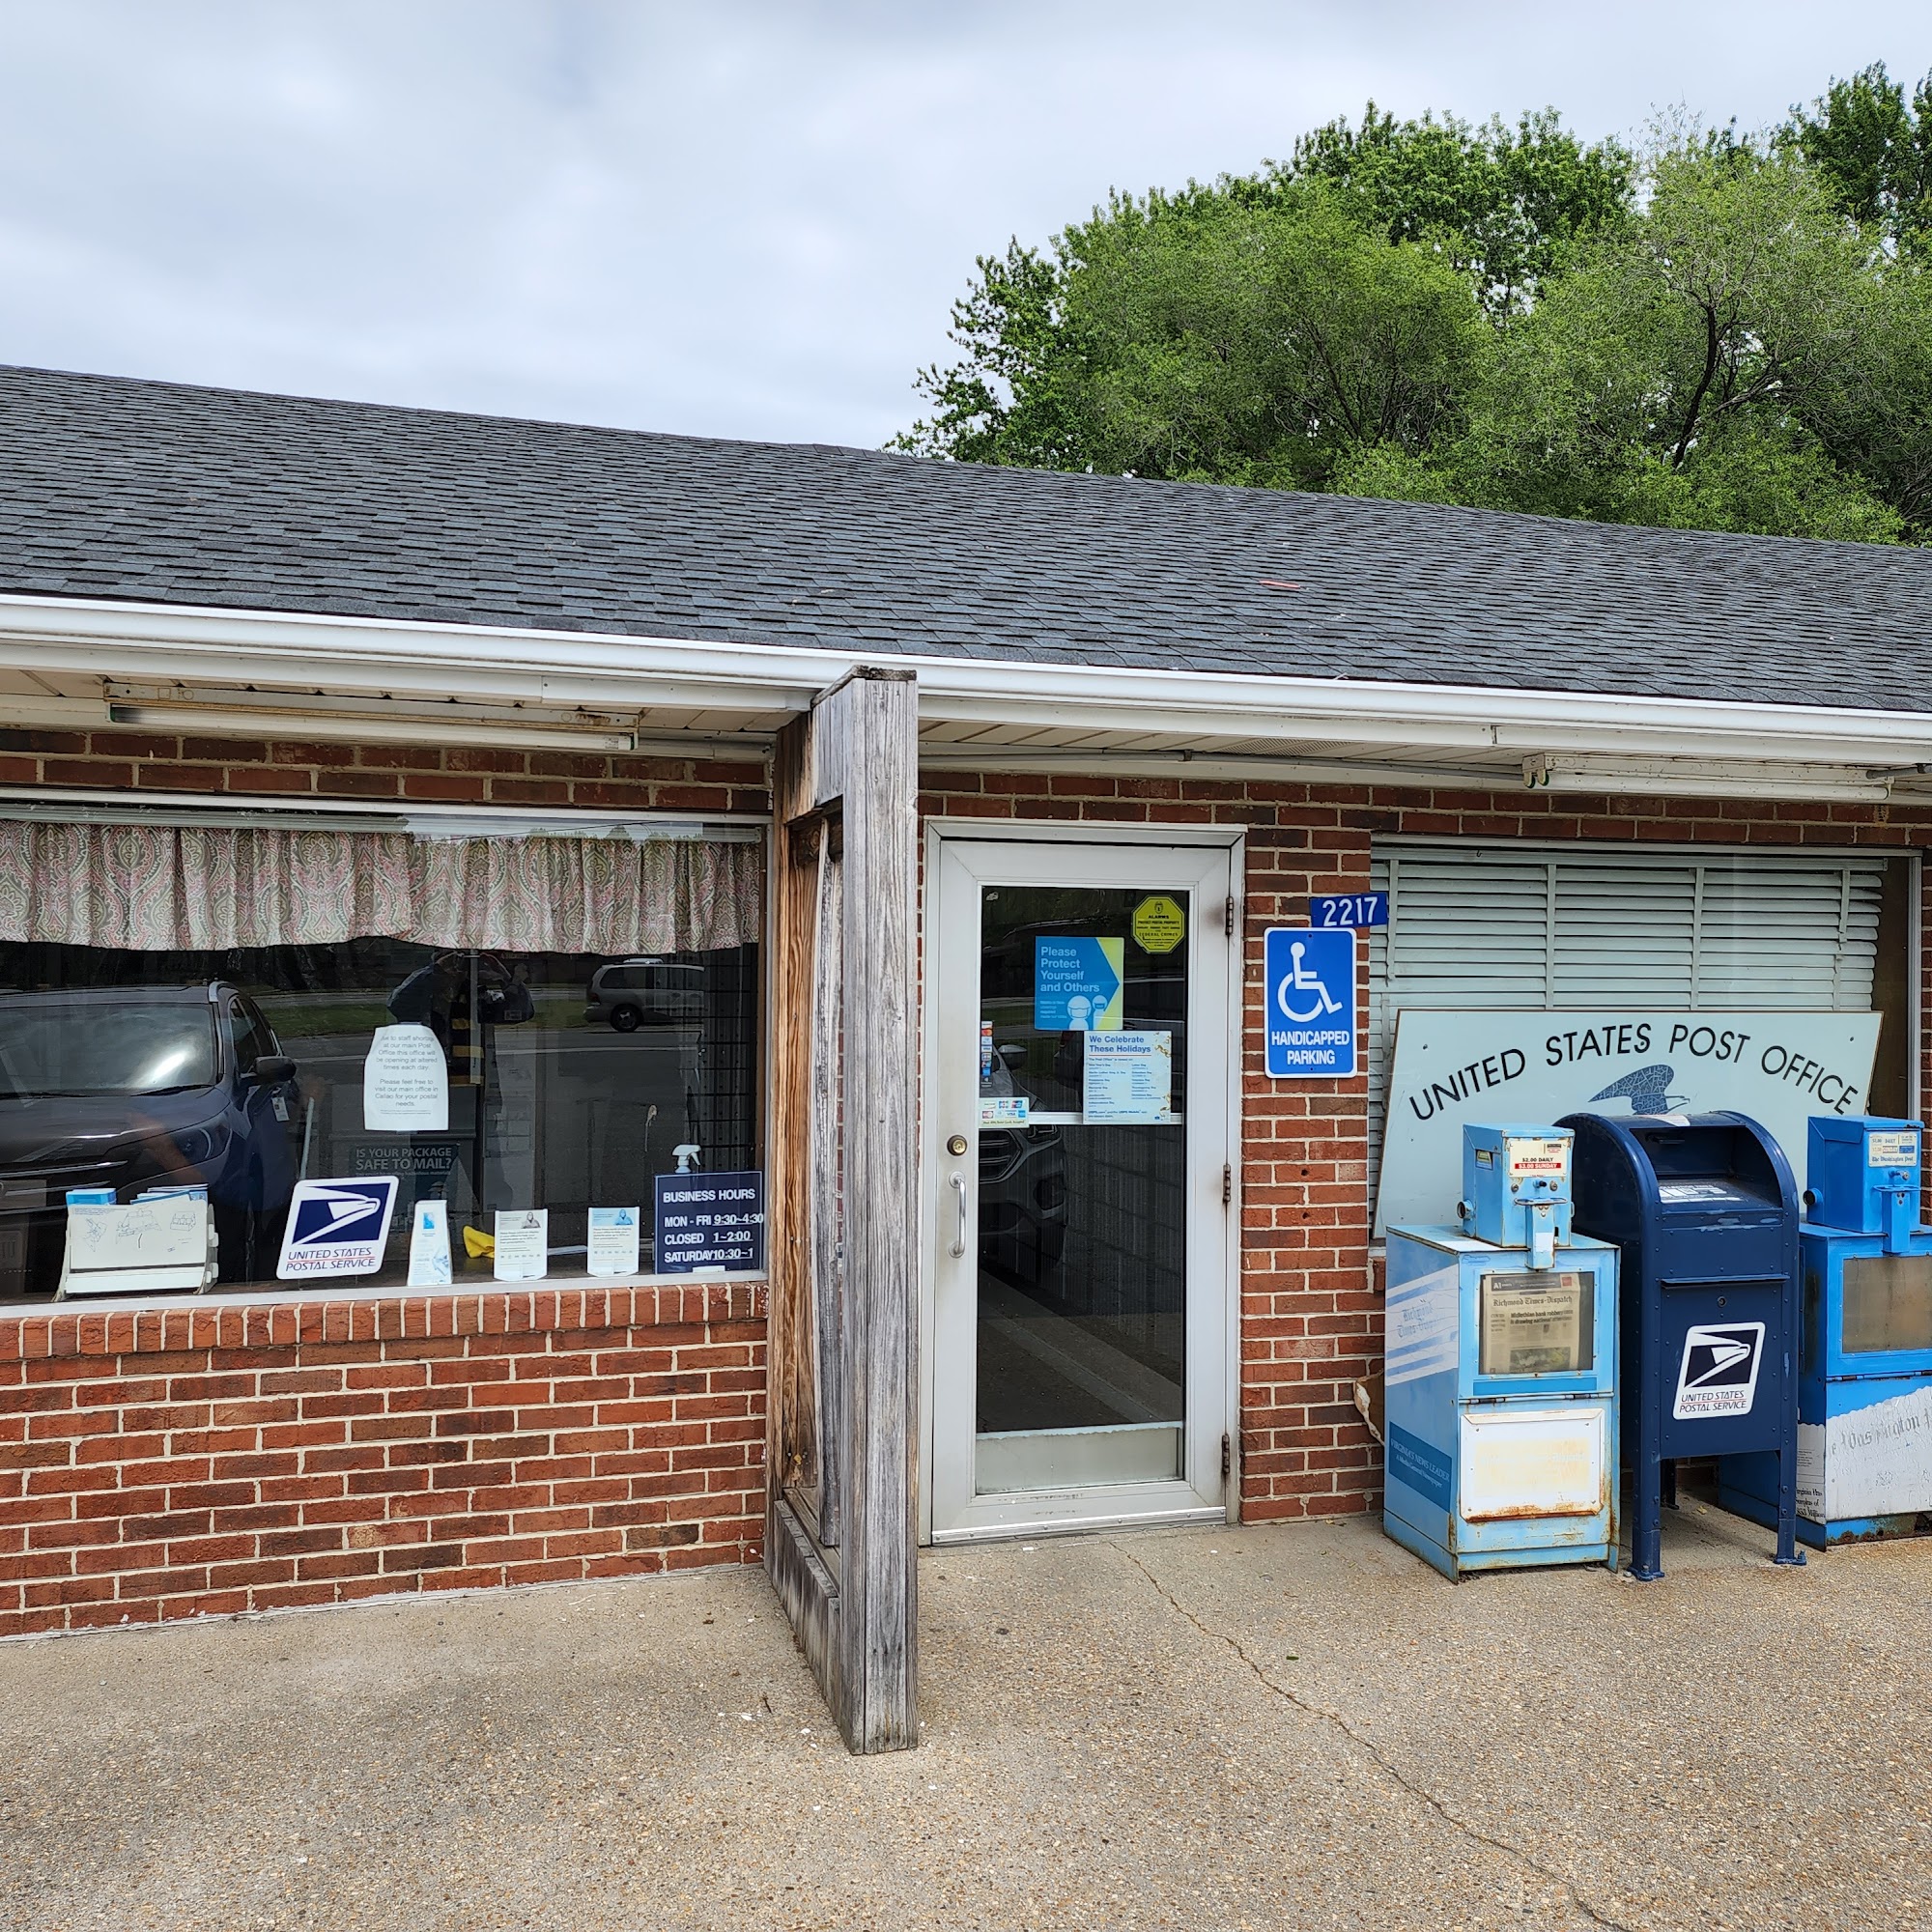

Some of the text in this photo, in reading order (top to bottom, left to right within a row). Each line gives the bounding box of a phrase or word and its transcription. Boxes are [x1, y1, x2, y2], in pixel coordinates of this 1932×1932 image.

[1321, 896, 1378, 927] 2217
[1040, 946, 1077, 957] Please
[1040, 957, 1081, 969] Protect
[1039, 970, 1085, 980] Yourself
[1039, 981, 1100, 992] and Others
[1089, 1035, 1145, 1043] We Celebrate
[1271, 1031, 1350, 1046] HANDICAPPED
[1116, 1045, 1151, 1054] Holidays
[1287, 1050, 1336, 1065] PARKING
[1409, 1023, 1859, 1121] UNITED STATES POST OFFICE
[355, 1147, 452, 1158] IS YOUR PACKAGE
[355, 1157, 453, 1171] SAFE TO MAIL?
[663, 1188, 756, 1204] BUSINESS HOURS
[664, 1216, 688, 1228] MON
[696, 1214, 712, 1226] FRI
[664, 1233, 705, 1245] CLOSED
[288, 1246, 373, 1260] UNITED STATES
[664, 1249, 714, 1263] SATURDAY
[285, 1258, 377, 1271] POSTAL SERVICE
[1492, 1295, 1573, 1307] Richmond Times-Dispatch
[1681, 1390, 1745, 1403] UNITED STATES
[1679, 1400, 1747, 1413] POSTAL SERVICE
[1414, 1453, 1430, 1469] NEWS
[1429, 1462, 1450, 1483] LEADER
